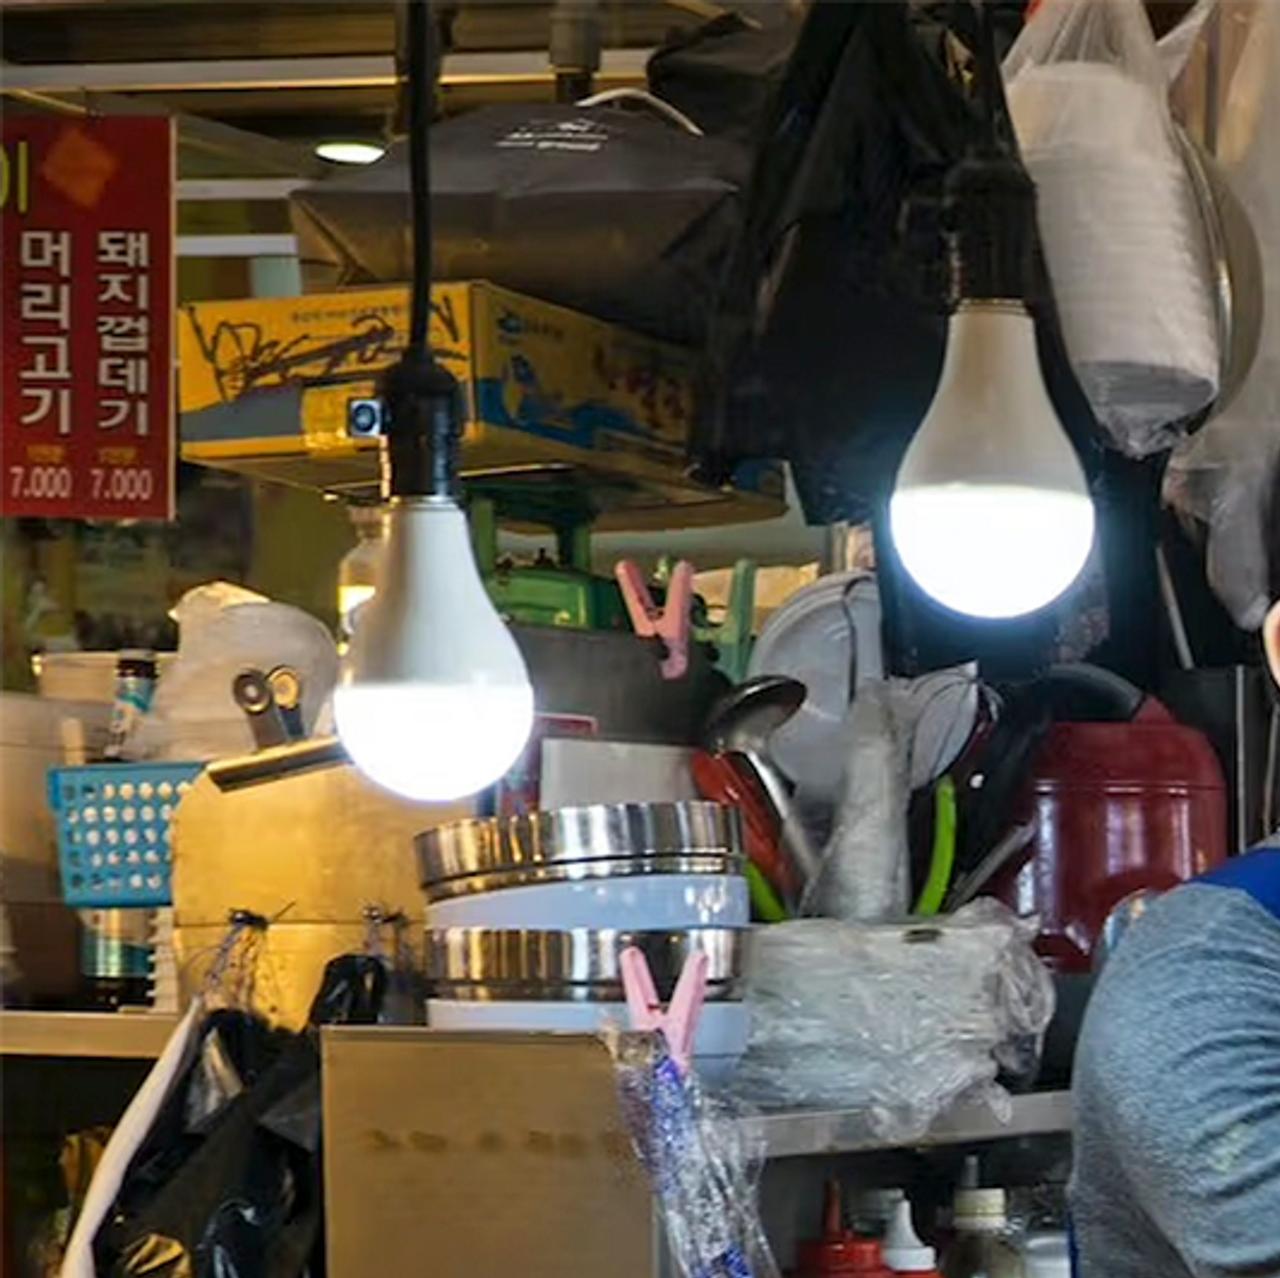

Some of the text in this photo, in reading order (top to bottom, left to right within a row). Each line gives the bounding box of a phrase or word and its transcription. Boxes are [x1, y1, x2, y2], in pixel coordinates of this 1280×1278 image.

[19, 231, 71, 434] 머리고기
[97, 231, 149, 436] 돼지껍데기
[10, 465, 73, 498] 7.000
[90, 467, 154, 500] 7.000
